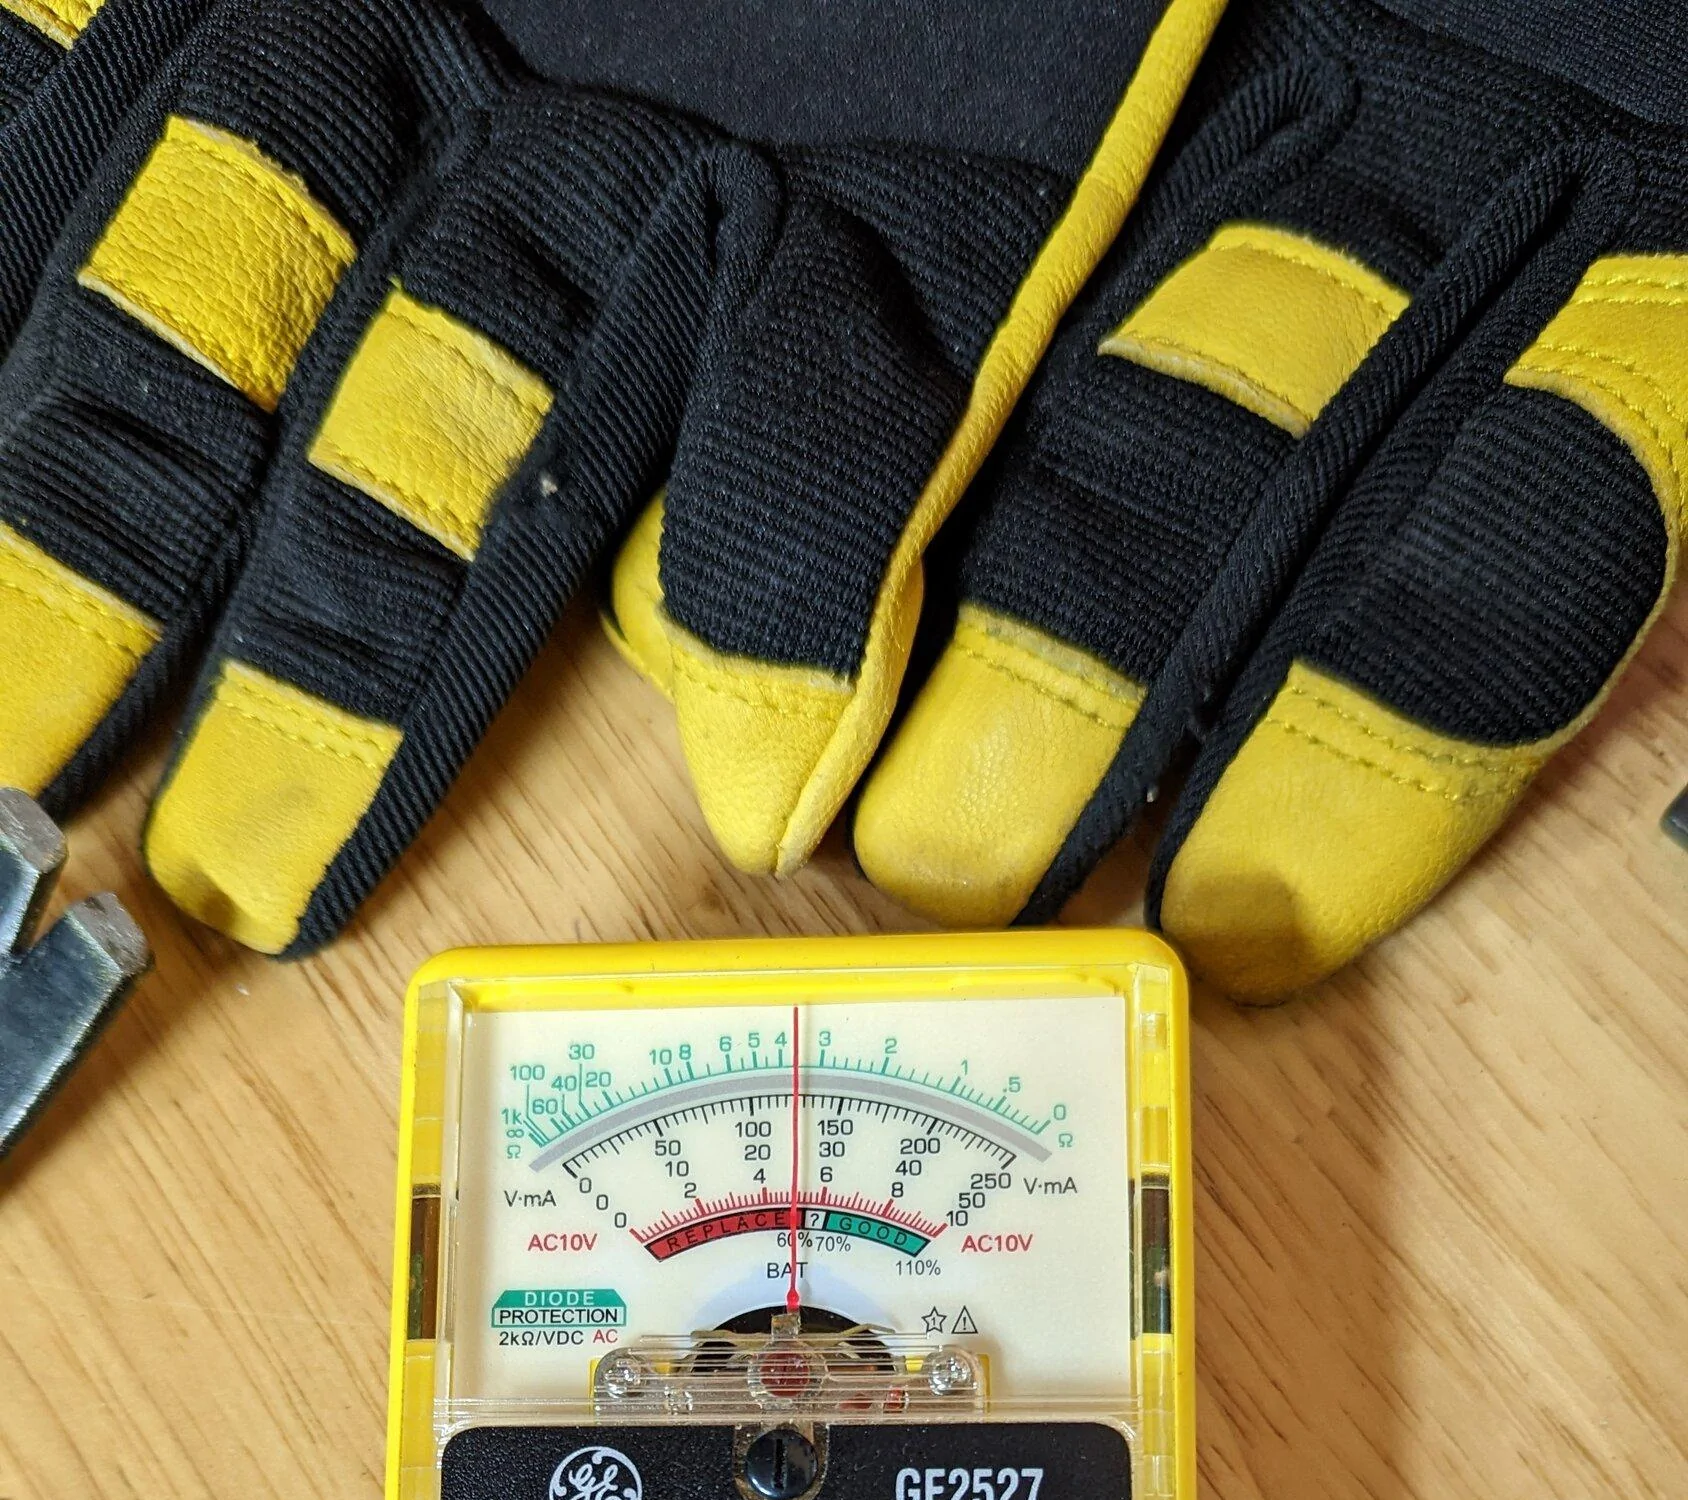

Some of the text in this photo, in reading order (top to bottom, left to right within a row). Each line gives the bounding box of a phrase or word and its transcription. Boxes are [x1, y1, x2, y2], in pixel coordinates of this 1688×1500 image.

[719, 1036, 731, 1051] 6
[749, 1033, 760, 1047] 5
[775, 1032, 787, 1046] 4
[820, 1031, 830, 1046] 3
[885, 1039, 897, 1053] 2
[569, 1044, 595, 1060] 30
[649, 1050, 672, 1065] 10
[680, 1045, 691, 1060] 8
[511, 1065, 545, 1080] 100
[961, 1060, 968, 1074] 1
[551, 1075, 577, 1091] 40
[586, 1072, 611, 1087] 20
[1003, 1077, 1021, 1093] .5
[532, 1099, 558, 1114] 60
[1053, 1105, 1065, 1120] 0
[502, 1109, 522, 1124] 1k
[735, 1122, 771, 1137] 100
[818, 1120, 853, 1136] 150
[655, 1141, 680, 1156] 50
[745, 1145, 770, 1160] 20
[819, 1141, 844, 1157] 30
[901, 1138, 940, 1154] 200
[666, 1161, 688, 1177] 10
[820, 1167, 832, 1182] 6
[896, 1160, 921, 1176] 40
[753, 1169, 765, 1183] 4
[971, 1174, 1010, 1189] 250
[580, 1178, 591, 1193] 0
[684, 1183, 696, 1198] 2
[892, 1182, 903, 1197] 8
[597, 1195, 608, 1210] 0
[959, 1193, 985, 1209] 50
[615, 1213, 627, 1228] 0
[811, 1213, 820, 1227] ?
[946, 1210, 968, 1226] 10
[667, 1212, 785, 1250] REPLACE
[839, 1217, 907, 1246] GOOD
[528, 1234, 597, 1251] AC10V
[816, 1236, 851, 1252] 70%
[961, 1234, 1033, 1252] AC10V
[768, 1262, 808, 1278] BAT
[896, 1260, 941, 1276] 110%
[525, 1291, 594, 1305] DIODE
[500, 1309, 617, 1324] PROTECTION
[593, 1329, 618, 1343] AC
